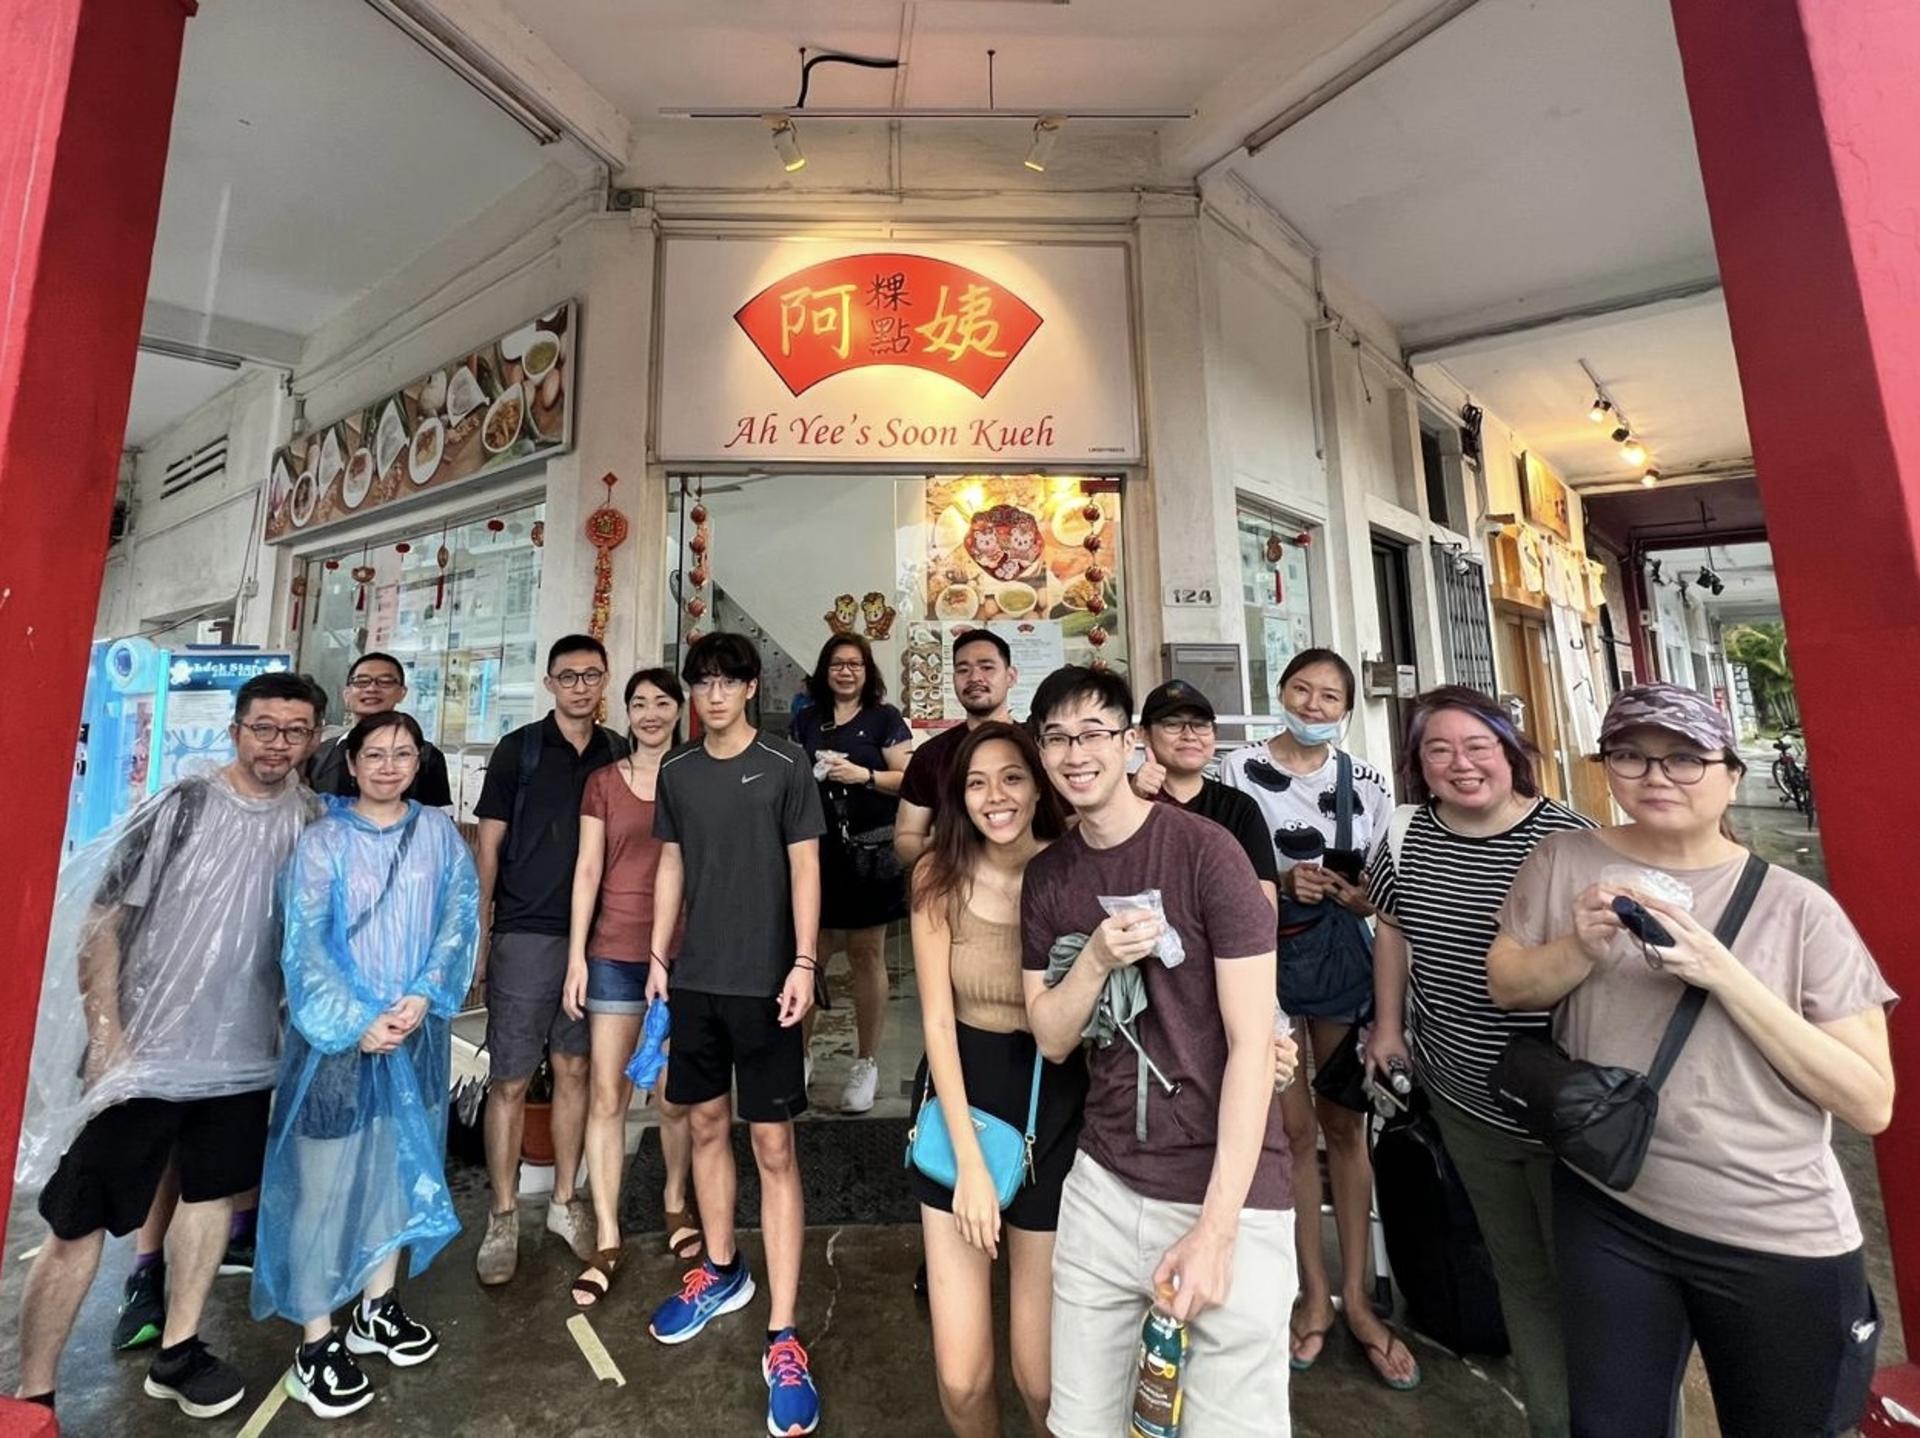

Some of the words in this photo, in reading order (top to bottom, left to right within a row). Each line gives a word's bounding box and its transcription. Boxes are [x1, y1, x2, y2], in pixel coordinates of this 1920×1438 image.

[779, 283, 858, 359] 阿
[914, 284, 1008, 361] 姨
[724, 413, 778, 448] Ah
[790, 414, 871, 445] Yee's
[878, 418, 959, 448] Soon
[969, 415, 1055, 452] Kueh
[1173, 589, 1212, 604] 124
